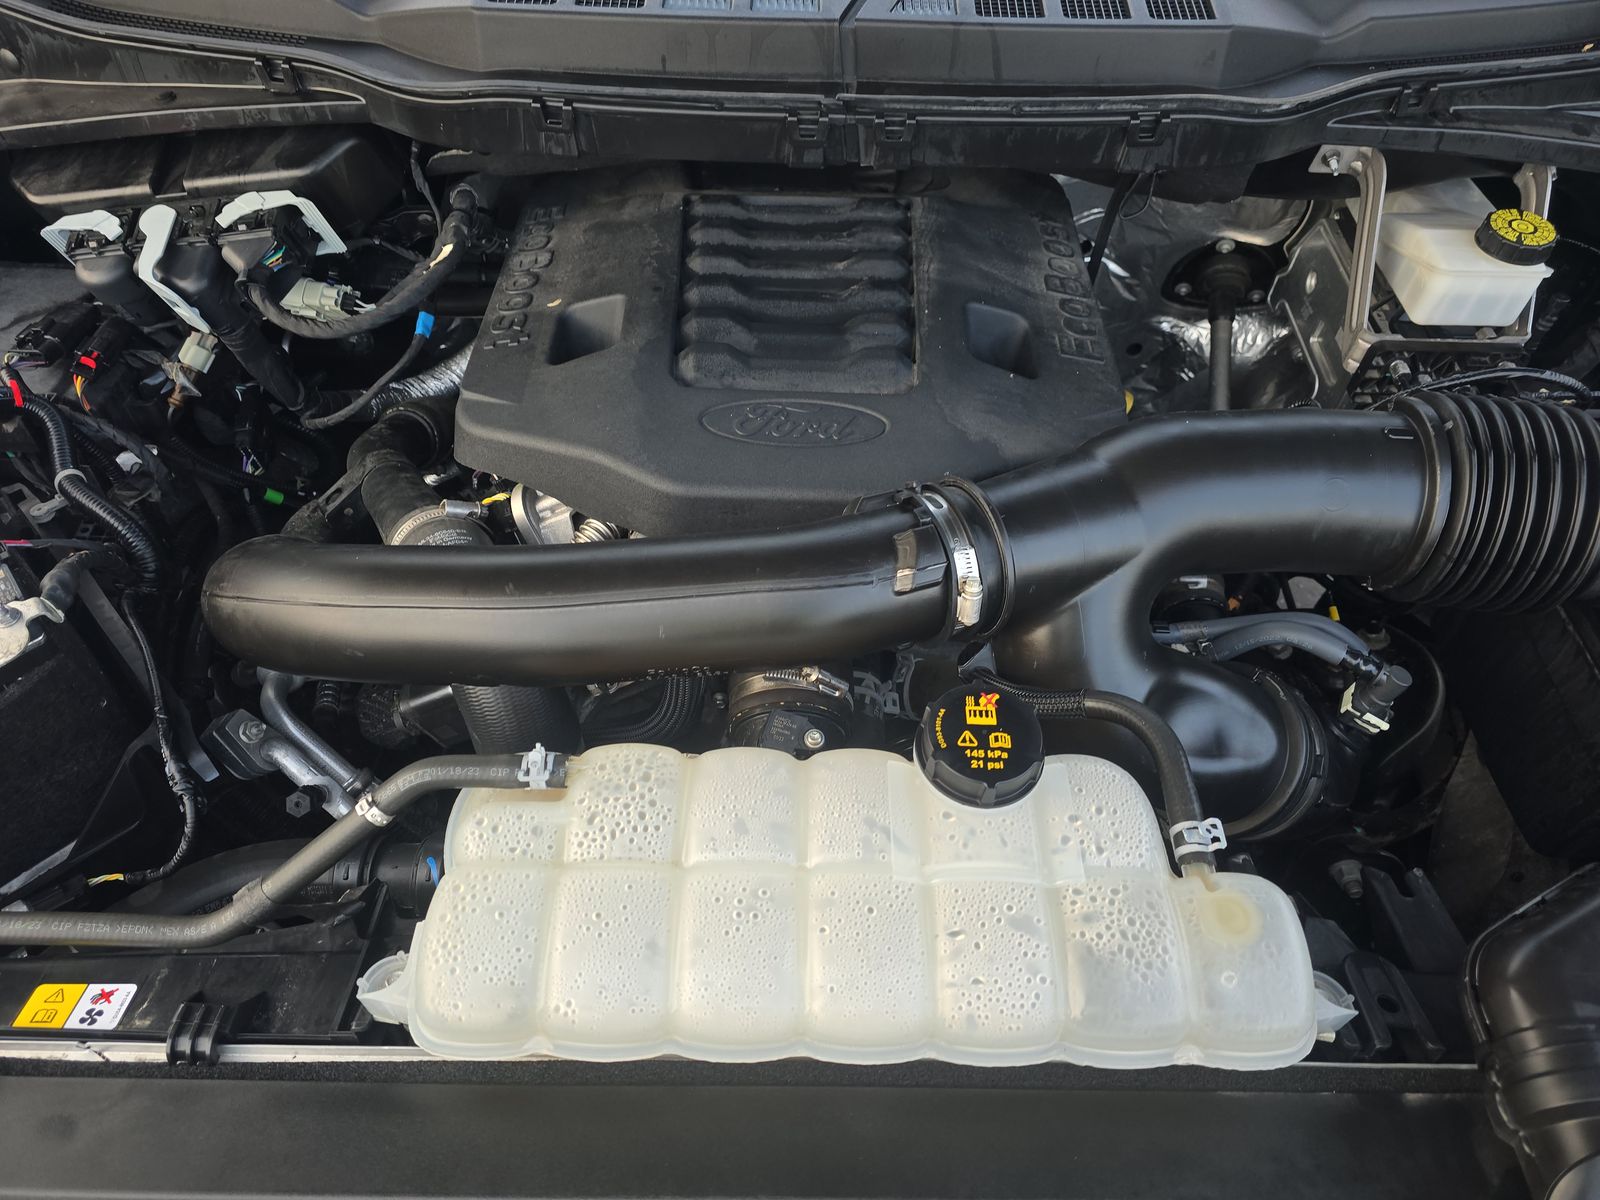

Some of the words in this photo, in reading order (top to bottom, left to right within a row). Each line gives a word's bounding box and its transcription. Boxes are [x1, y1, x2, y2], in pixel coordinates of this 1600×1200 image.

[484, 204, 567, 349] ECOBOOST
[733, 403, 857, 440] Ford
[965, 749, 984, 758] 145
[987, 749, 1008, 759] kPa
[971, 760, 983, 769] 21
[987, 760, 1004, 770] psi
[490, 767, 510, 777] CIP
[51, 920, 73, 931] CIP
